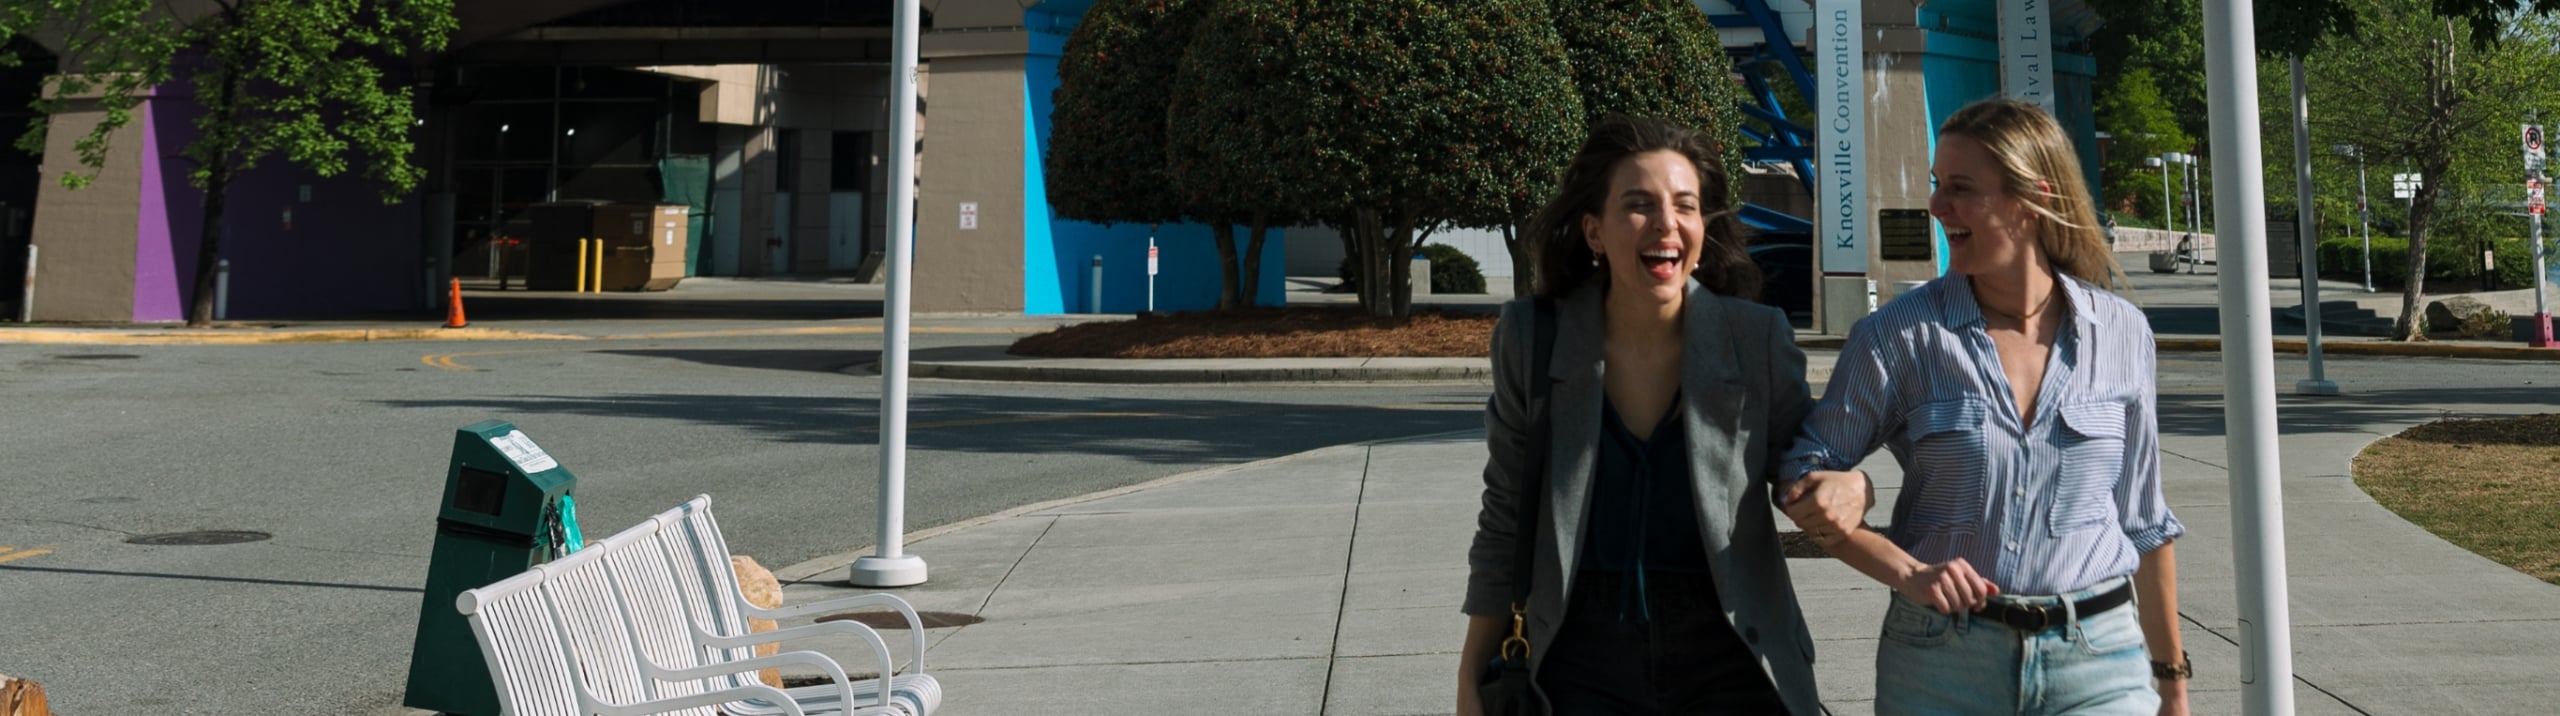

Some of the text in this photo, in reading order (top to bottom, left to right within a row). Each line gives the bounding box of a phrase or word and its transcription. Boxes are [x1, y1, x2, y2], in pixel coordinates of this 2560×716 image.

[1832, 9, 1853, 250] Knoxville Convention
[2021, 54, 2040, 106] ival
